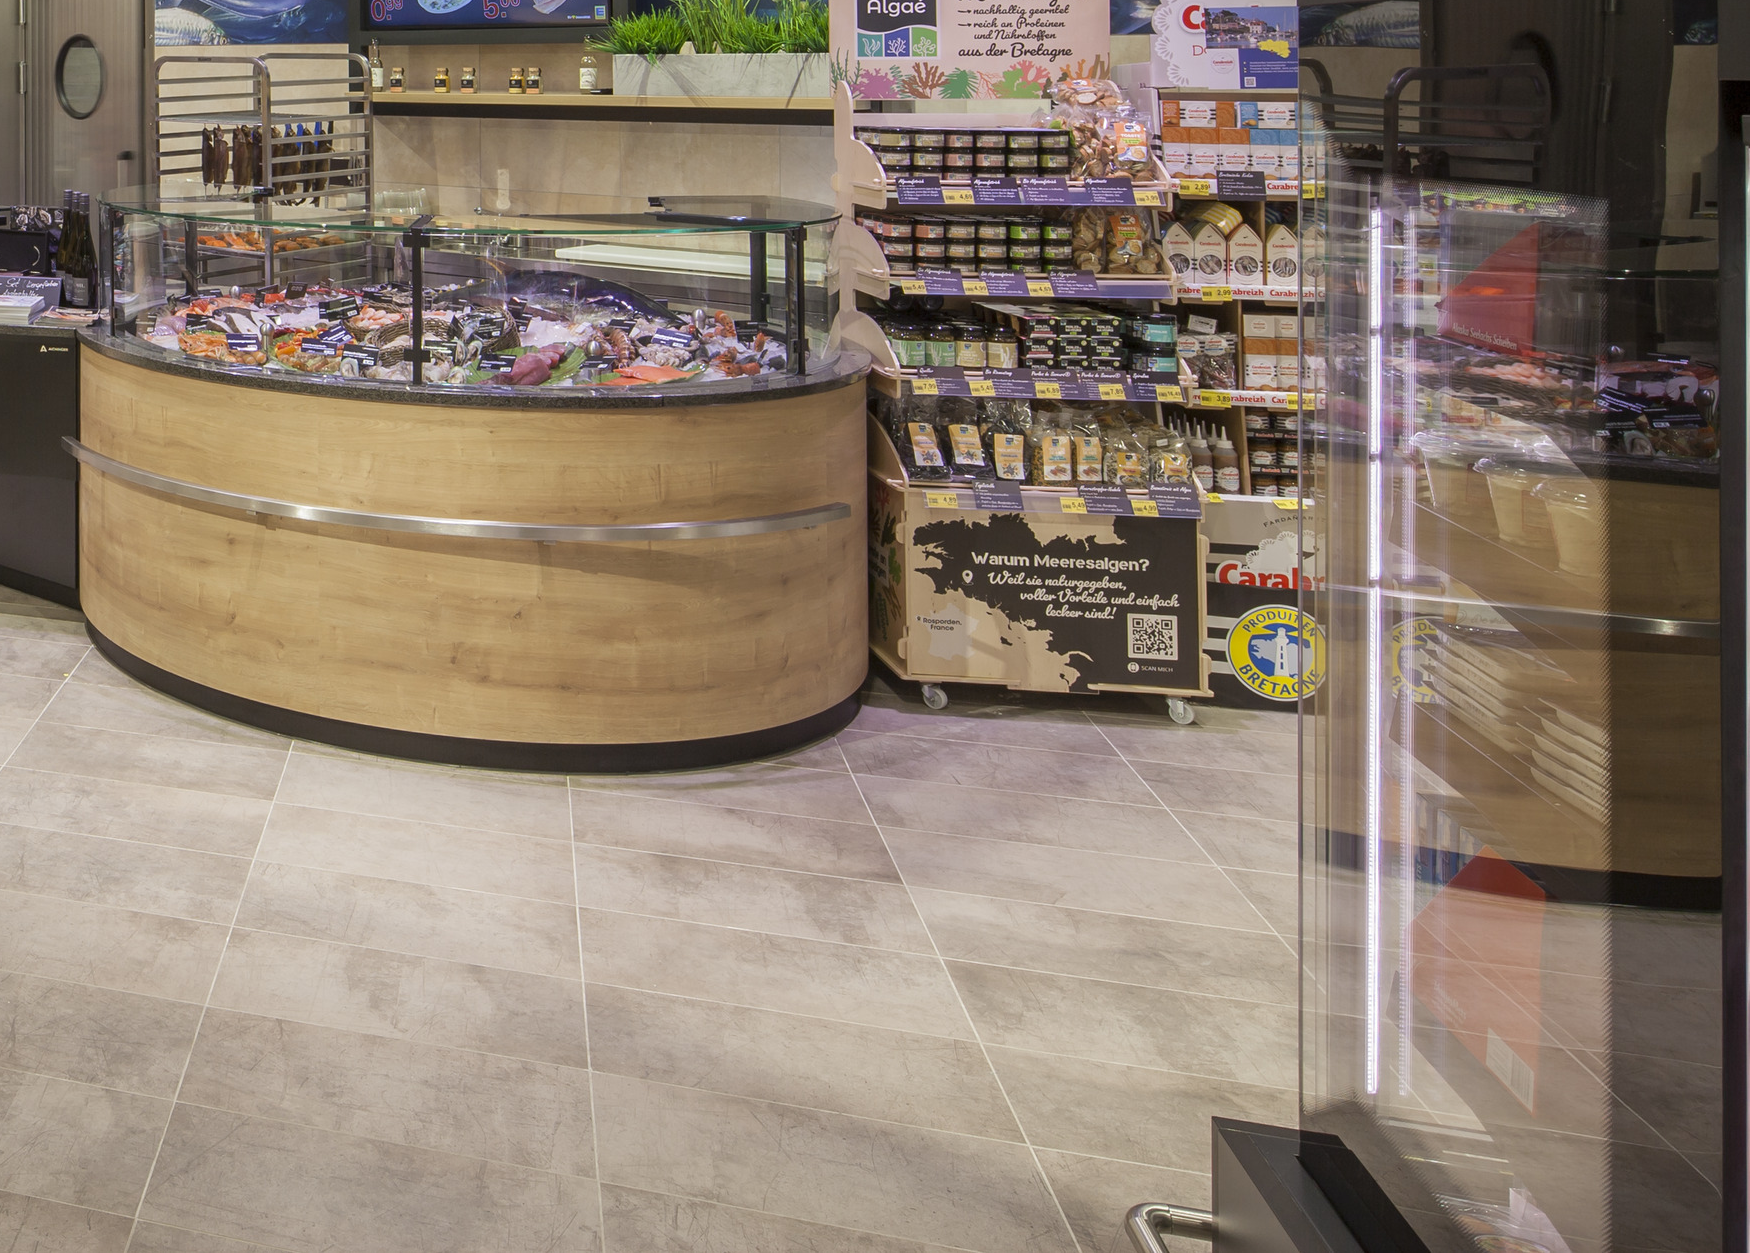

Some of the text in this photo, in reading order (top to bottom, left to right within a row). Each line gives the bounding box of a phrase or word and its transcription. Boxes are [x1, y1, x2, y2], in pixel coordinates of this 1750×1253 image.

[973, 4, 1070, 18] nachhaltig geerntet
[973, 17, 1066, 30] reich an Proteinen
[973, 29, 1057, 42] und Nährstoffen
[958, 42, 1073, 63] aus der Bretagne
[1194, 183, 1209, 192] 2,89
[1267, 182, 1299, 191] Carabre
[1232, 288, 1264, 296] arabreizh
[1452, 322, 1518, 351] Alaska Seelachs Scheiben
[1216, 395, 1231, 403] 3,89
[1231, 395, 1266, 404] rabreizh
[971, 551, 1150, 573] Warum Meeresalgen?
[987, 571, 1127, 593] Weil sie naturgegeben,
[1020, 590, 1181, 611] voller Vorteile und einfach
[1045, 604, 1117, 620] lecker sind!
[922, 617, 963, 627] Rosporden,
[930, 624, 955, 632] France
[1242, 610, 1300, 633] PRODUIT
[1140, 665, 1157, 673] SCAN
